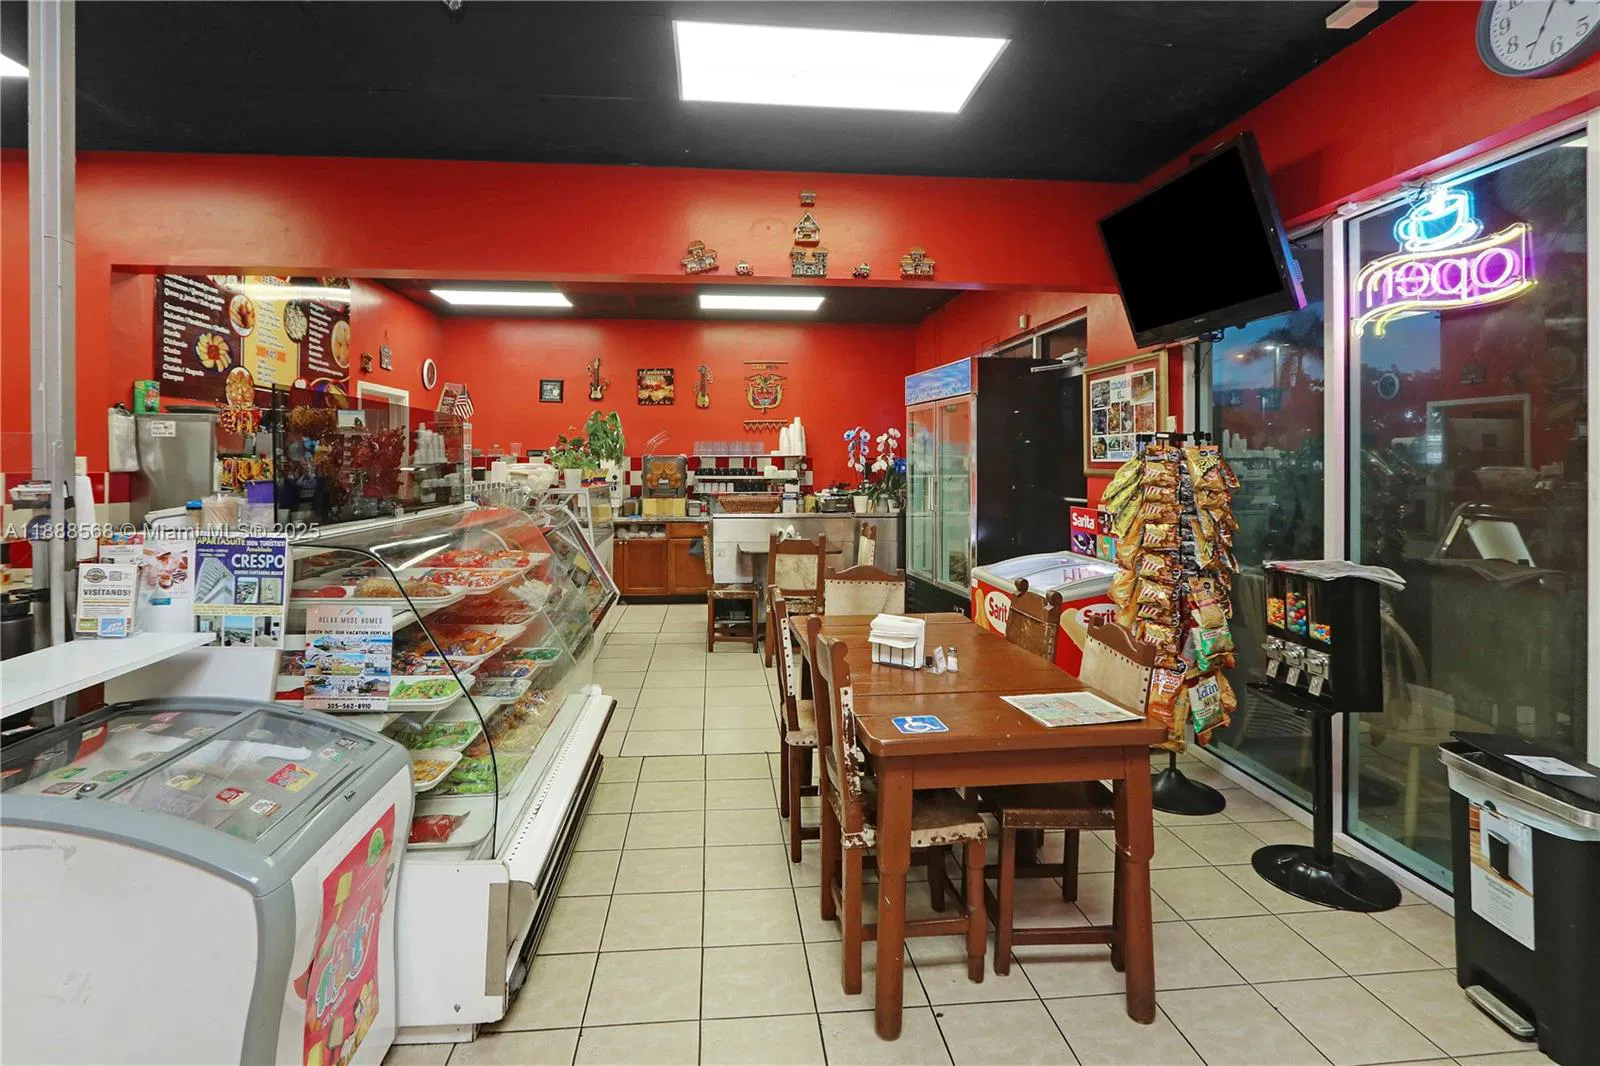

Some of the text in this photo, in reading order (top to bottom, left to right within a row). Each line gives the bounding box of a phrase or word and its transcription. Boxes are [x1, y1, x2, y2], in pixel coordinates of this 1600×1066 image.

[1499, 17, 1510, 36] 9
[1576, 15, 1589, 37] 5
[1507, 35, 1519, 54] 8
[1550, 34, 1563, 55] 6
[1072, 512, 1095, 530] Sarita
[231, 553, 285, 569] CRESPO
[989, 596, 1009, 625] Sarit
[340, 616, 358, 624] MODE
[361, 617, 383, 625] HOMES
[1196, 683, 1219, 702] Latin
